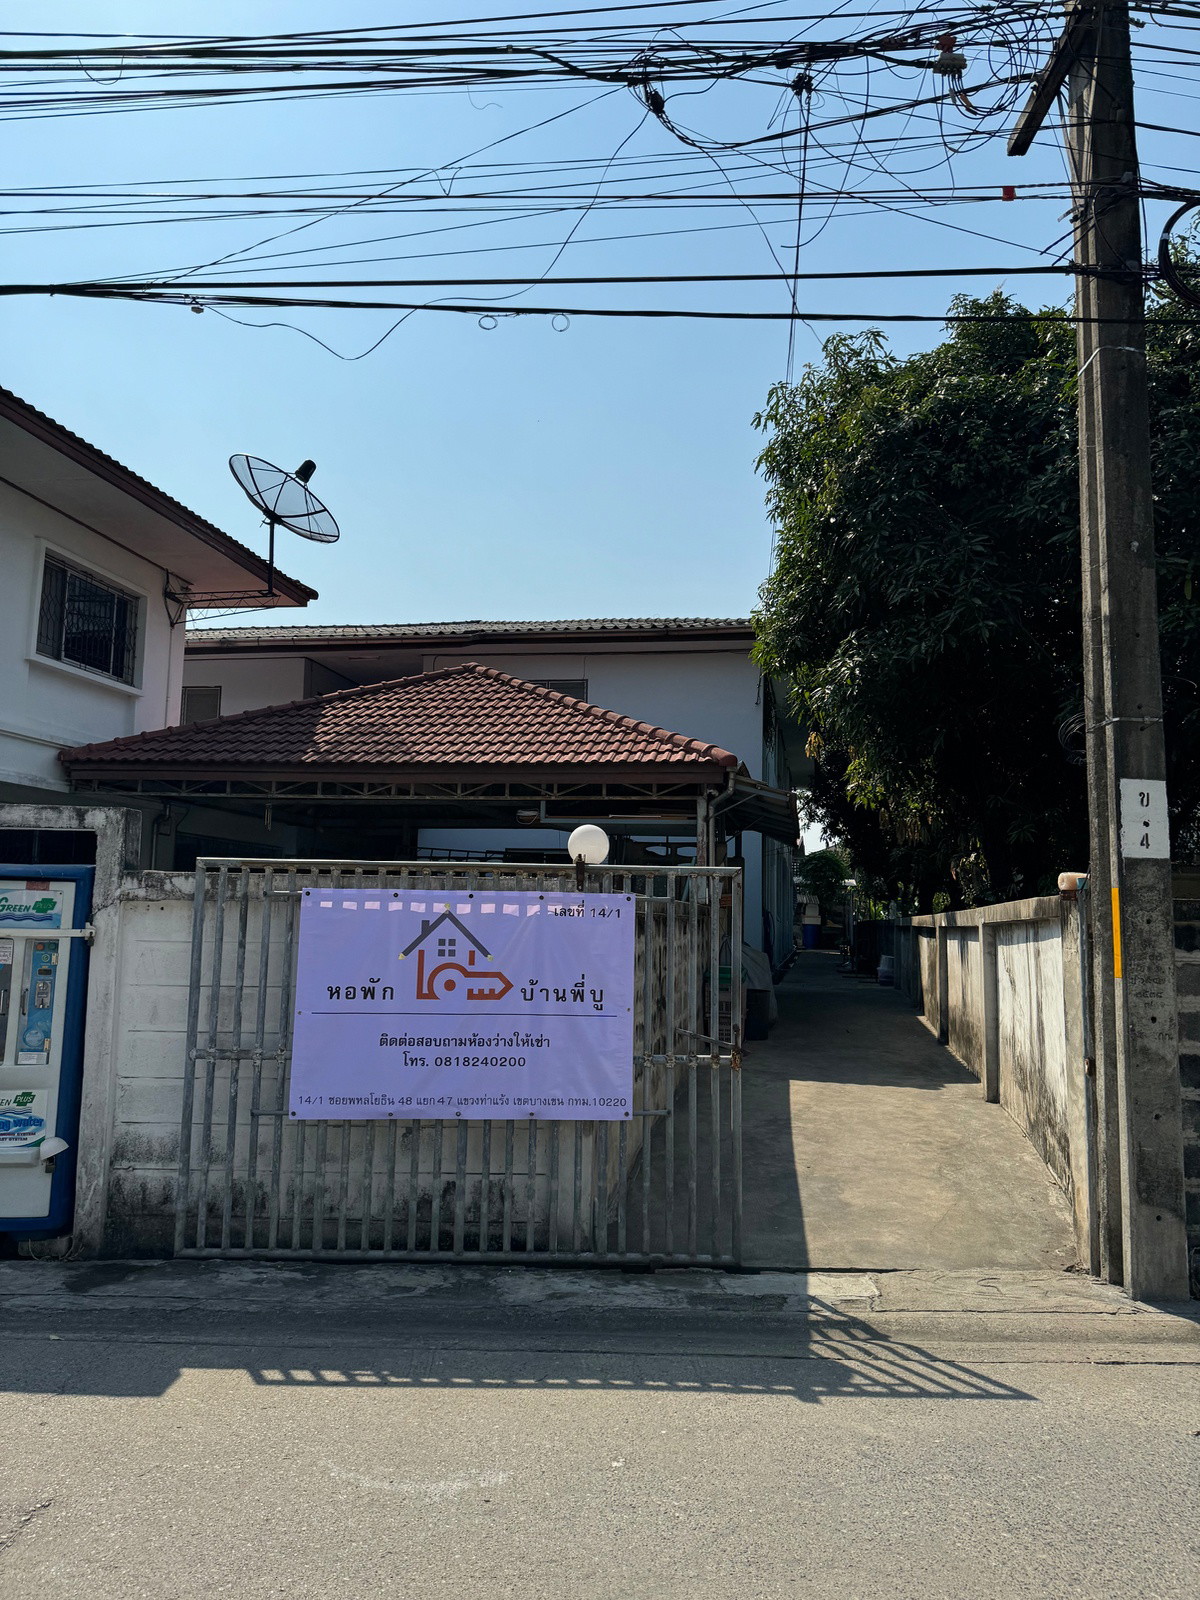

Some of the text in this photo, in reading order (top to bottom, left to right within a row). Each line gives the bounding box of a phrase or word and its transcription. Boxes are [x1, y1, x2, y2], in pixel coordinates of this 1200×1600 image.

[1140, 832, 1150, 849] 4
[554, 900, 621, 918] เลขที่ 14/1
[327, 974, 604, 1011] หอพัก บ้านพี่บู
[379, 1032, 550, 1048] ติดต่อสอบถามห้องว่างให้เช่า
[403, 1051, 526, 1067] โทร. 0818240200
[298, 1096, 323, 1105] 14/1
[328, 1092, 395, 1106] ซอยพหลโยธิน
[398, 1096, 413, 1106] 48
[457, 1094, 510, 1107] แขวงท่าแร้ง
[513, 1097, 565, 1107] เขตบางเขน
